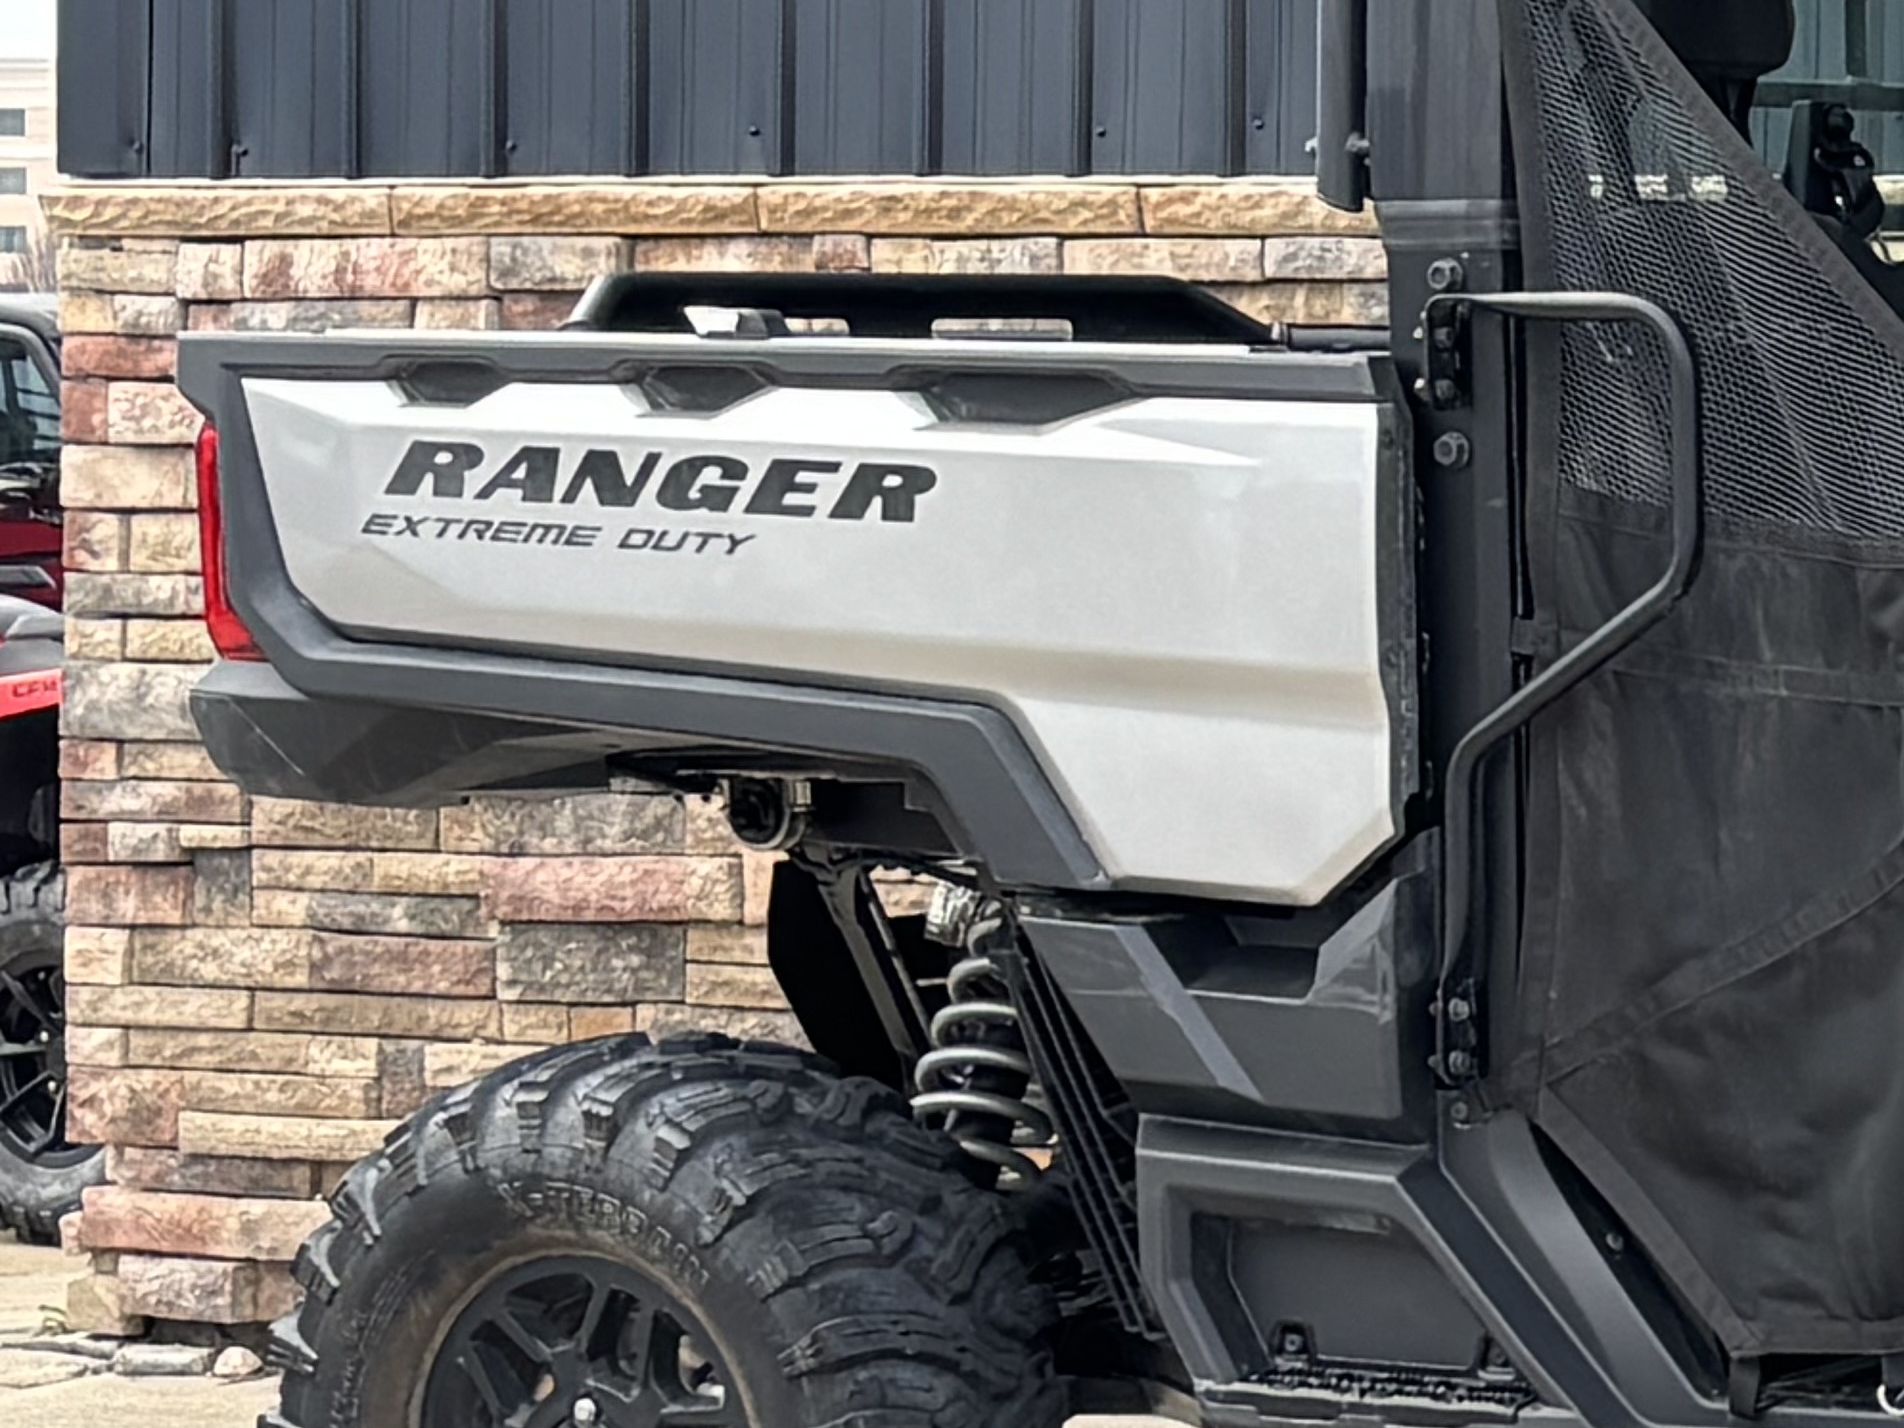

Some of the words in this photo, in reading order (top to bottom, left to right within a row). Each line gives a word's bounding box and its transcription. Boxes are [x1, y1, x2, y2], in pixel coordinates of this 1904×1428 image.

[383, 439, 937, 523] RANGER
[360, 513, 603, 549] EXTREME
[617, 527, 756, 555] DUTY
[12, 679, 59, 698] CFM
